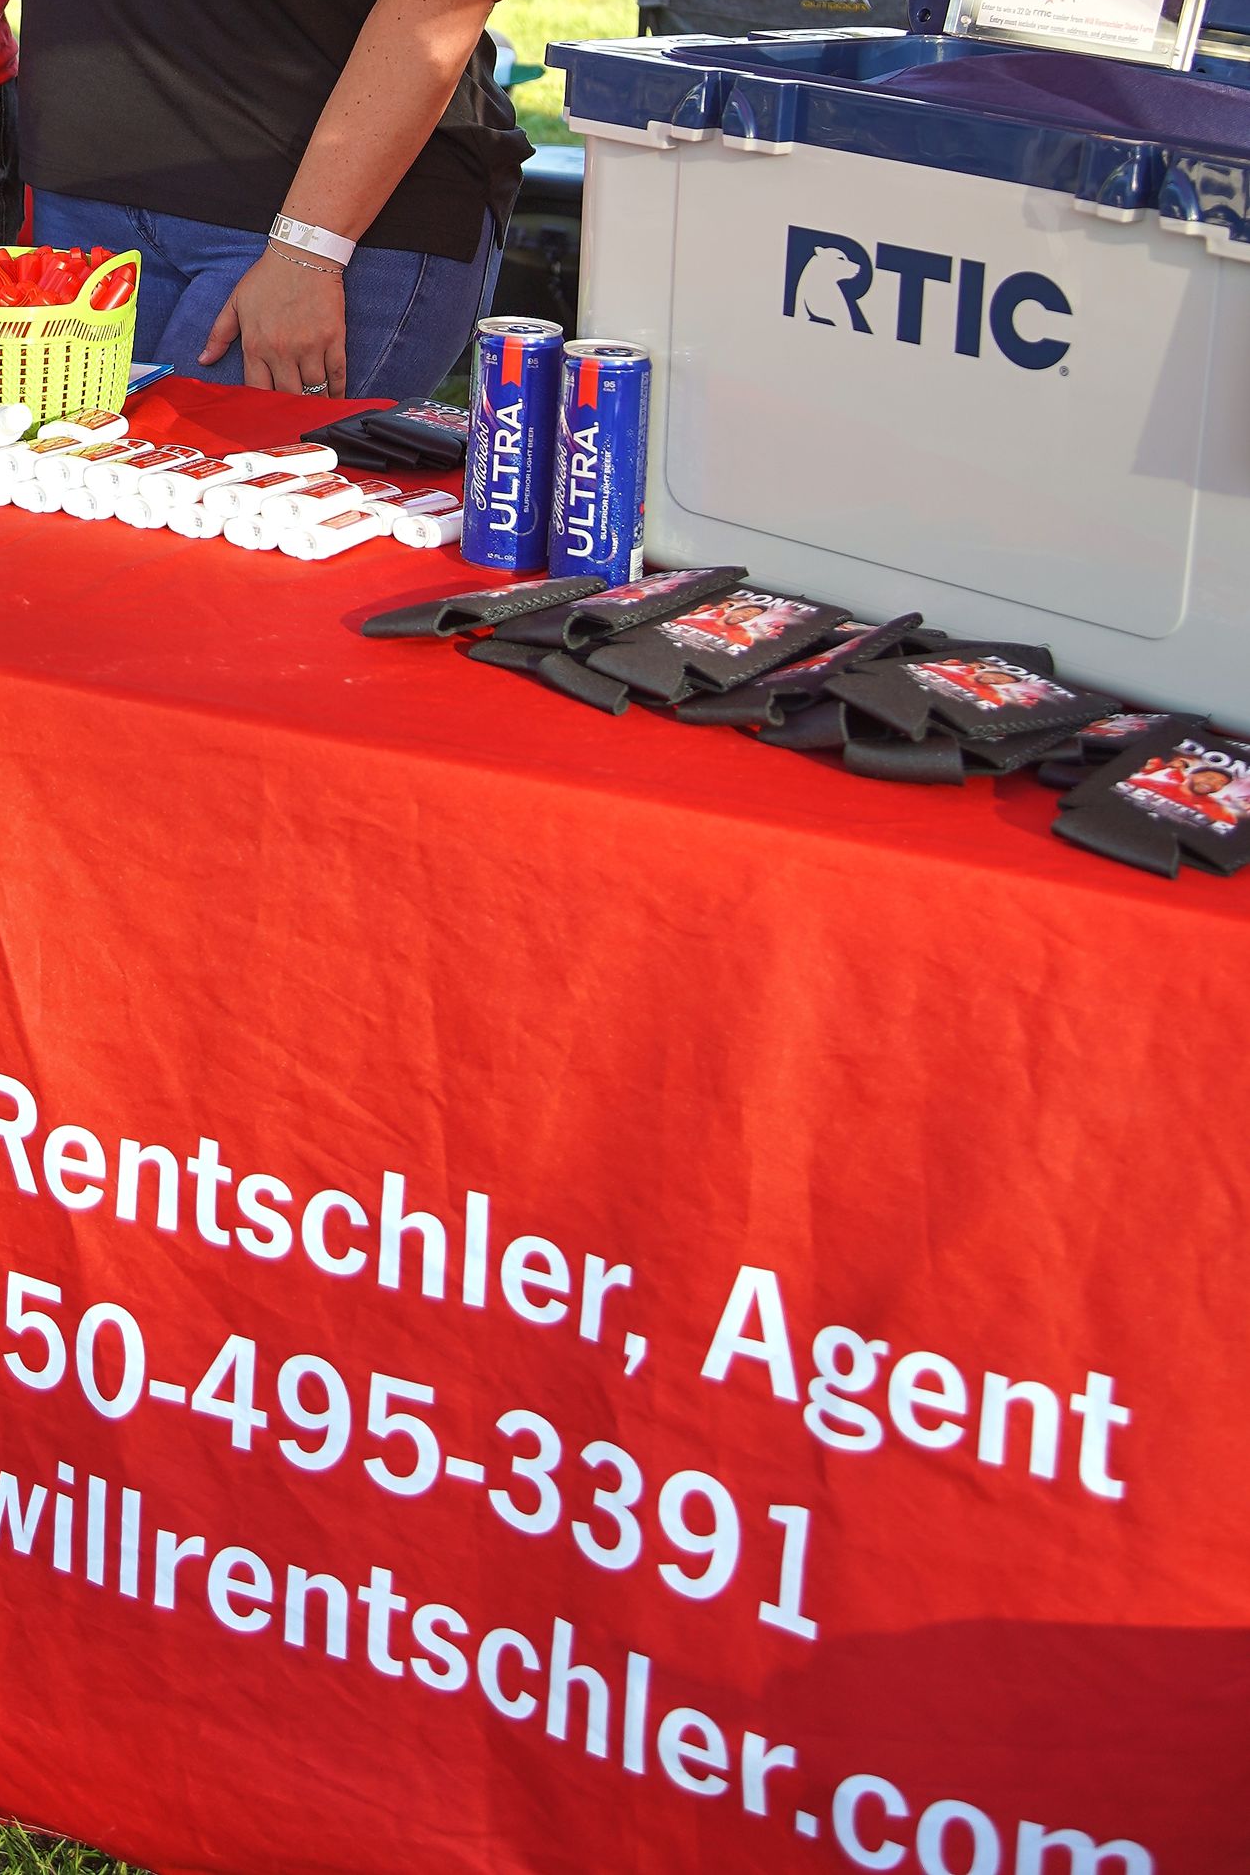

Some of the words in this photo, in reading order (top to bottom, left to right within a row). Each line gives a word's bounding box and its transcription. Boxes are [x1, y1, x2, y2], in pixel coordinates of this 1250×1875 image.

[783, 225, 1073, 370] RTIC
[527, 426, 535, 448] BEER
[471, 421, 491, 511] Michelob
[526, 449, 534, 473] LIGHT
[523, 473, 533, 513] SUPERIOR
[600, 498, 611, 540] SUPERIOR
[700, 1265, 1132, 1501] Agent
